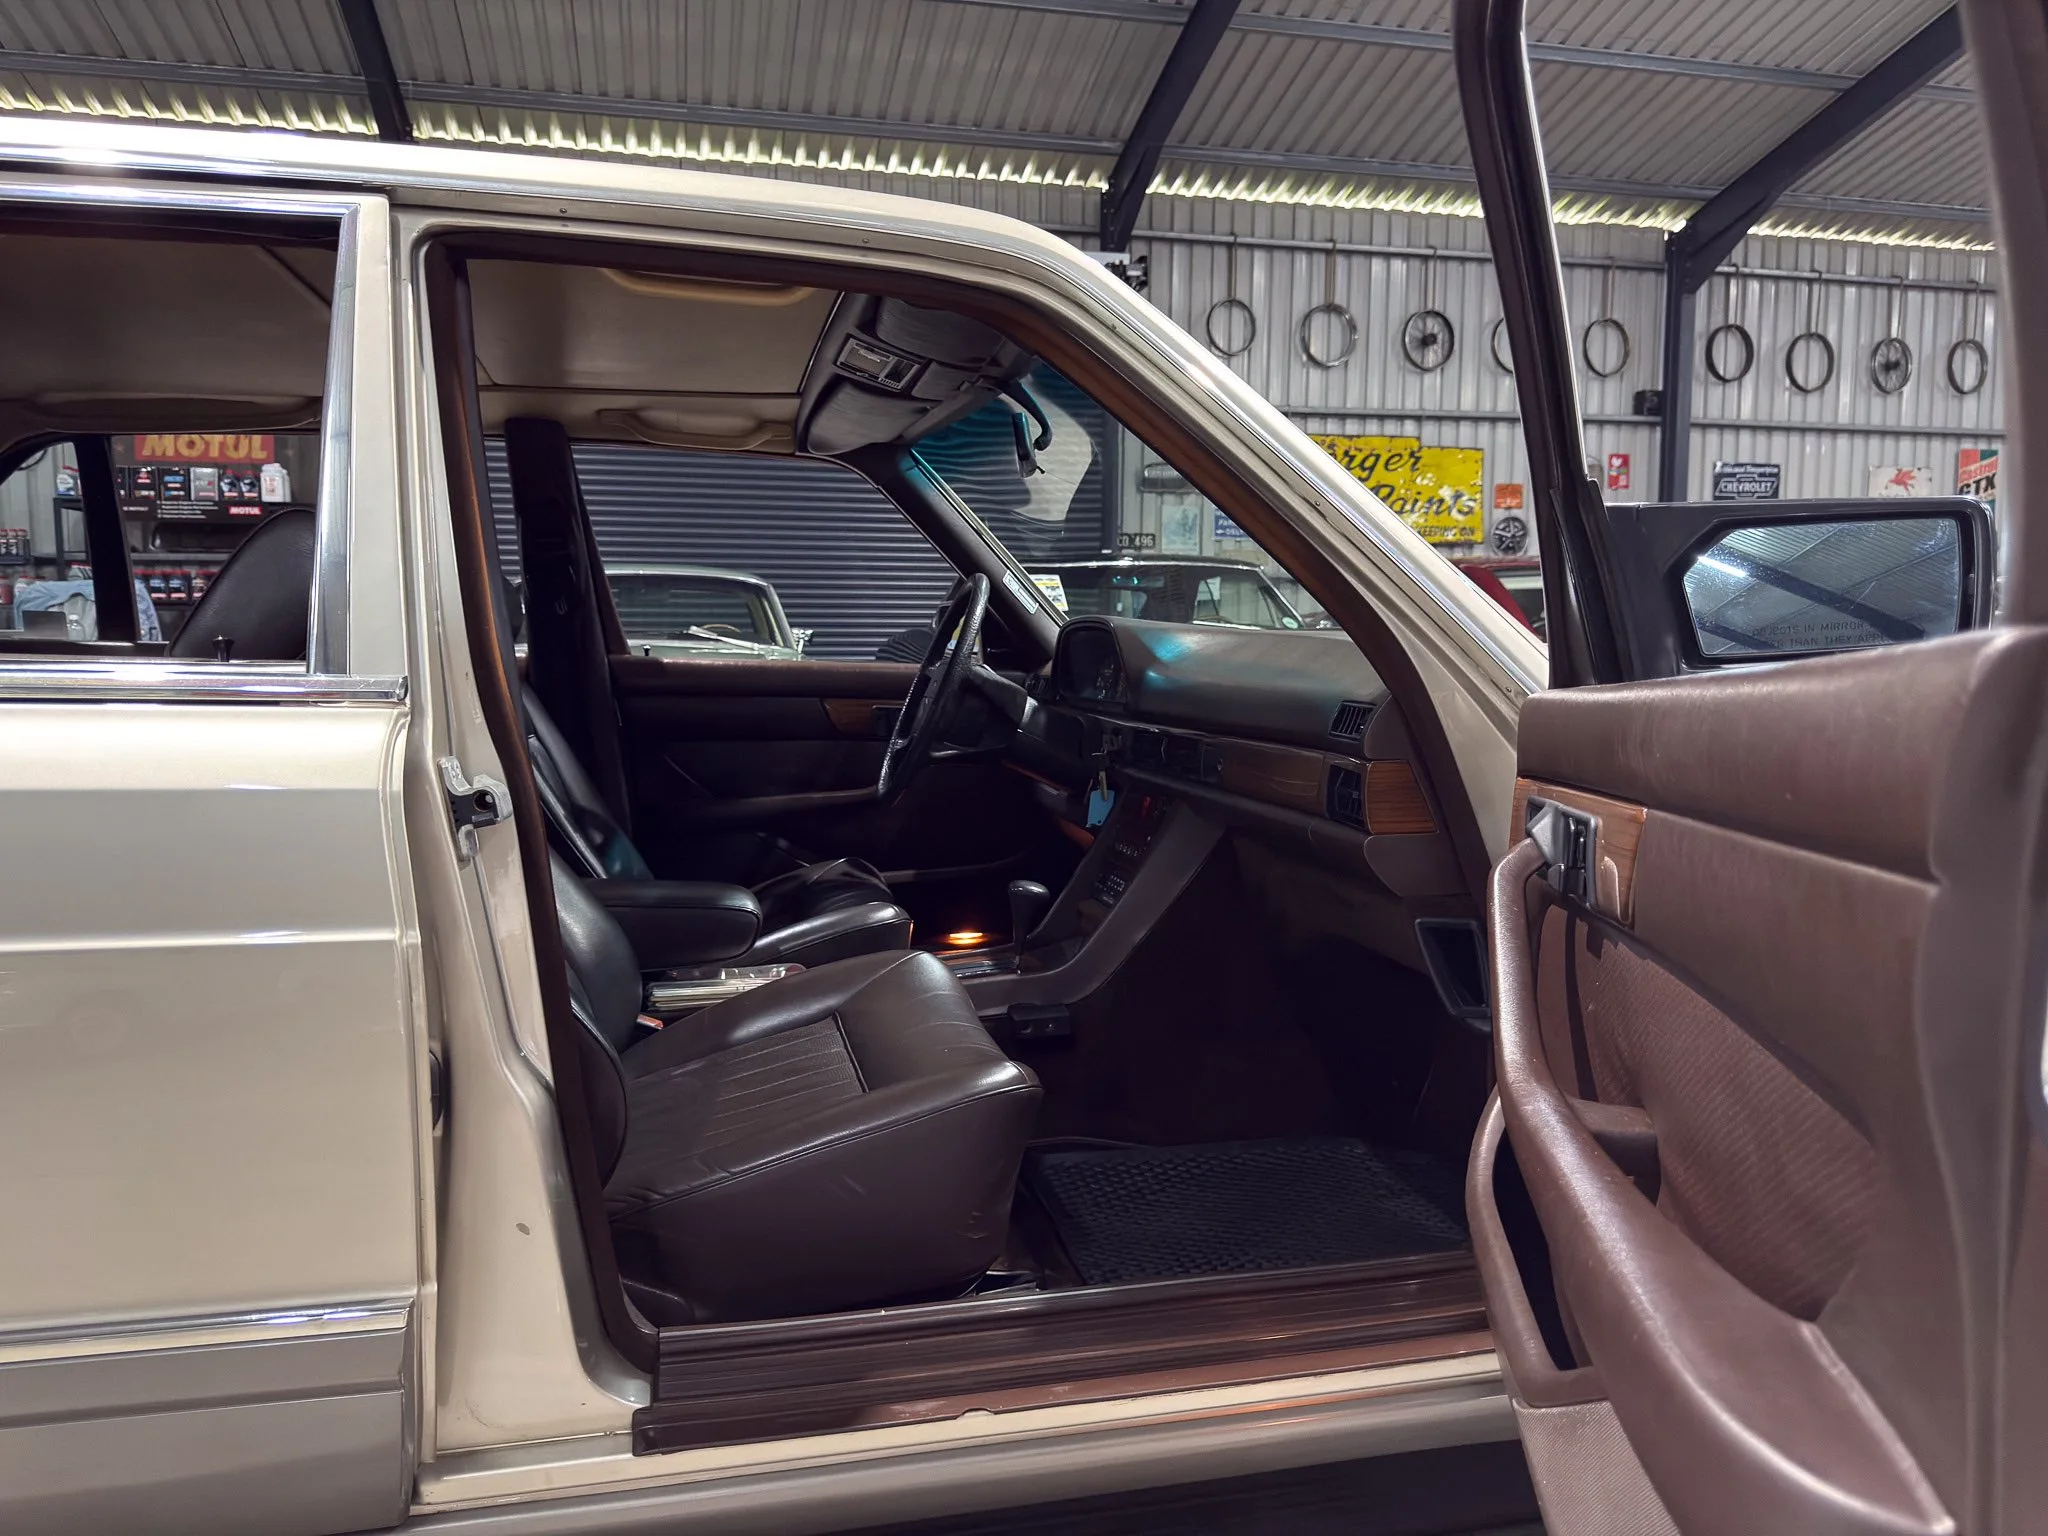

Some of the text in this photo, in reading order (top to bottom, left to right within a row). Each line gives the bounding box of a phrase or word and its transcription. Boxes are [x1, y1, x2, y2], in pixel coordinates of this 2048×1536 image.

[141, 434, 268, 460] MOTUL
[1338, 448, 1422, 482] rger
[1721, 481, 1772, 492] CHEVROLET
[229, 506, 261, 515] MOTUL
[1134, 535, 1154, 547] 496
